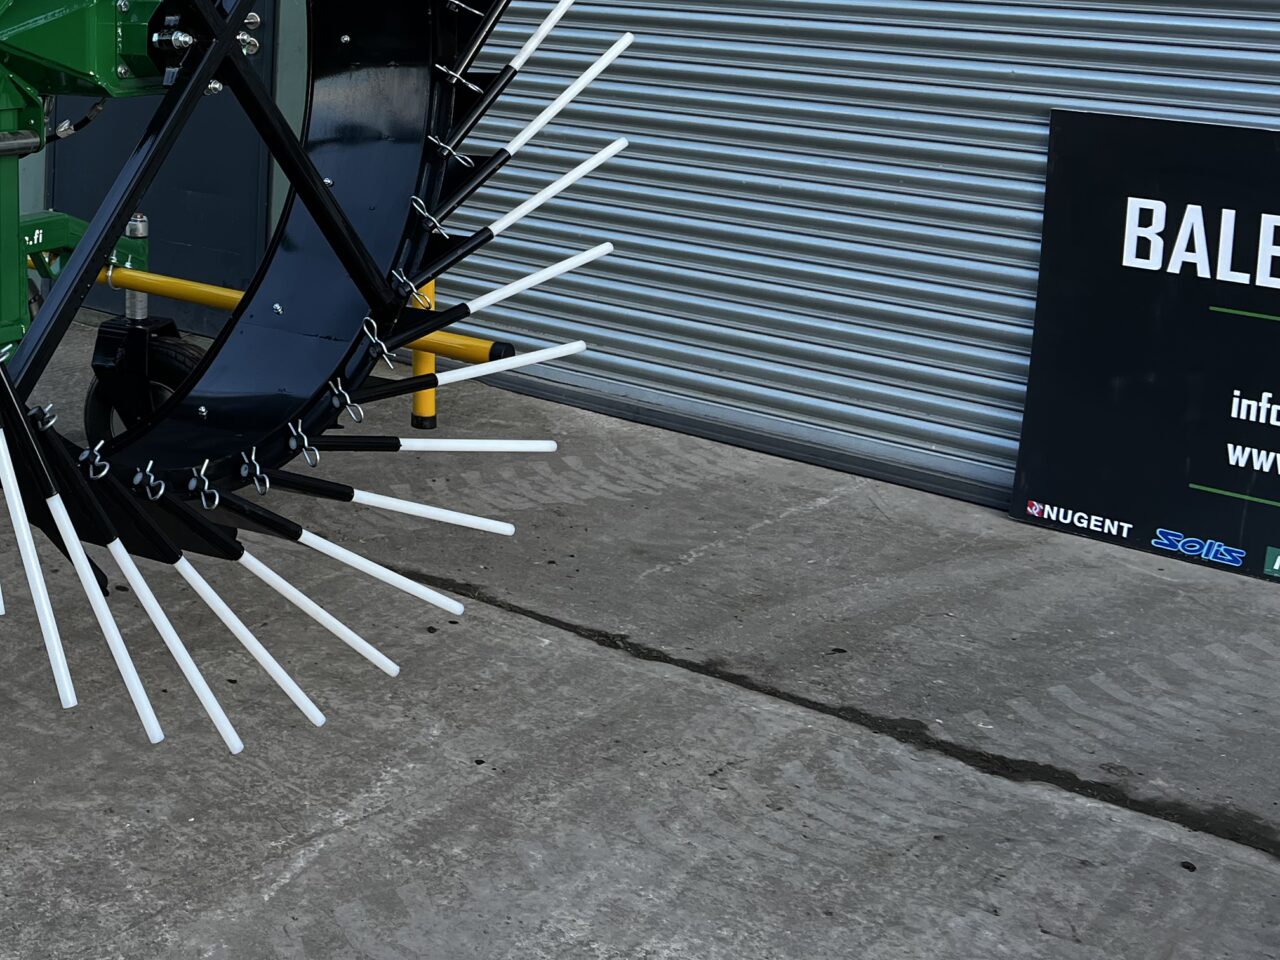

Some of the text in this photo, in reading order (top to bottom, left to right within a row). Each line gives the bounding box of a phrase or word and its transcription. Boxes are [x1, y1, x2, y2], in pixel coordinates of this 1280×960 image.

[1122, 197, 1280, 289] BALE
[1227, 443, 1280, 474] ww
[1043, 504, 1133, 538] NUGENT
